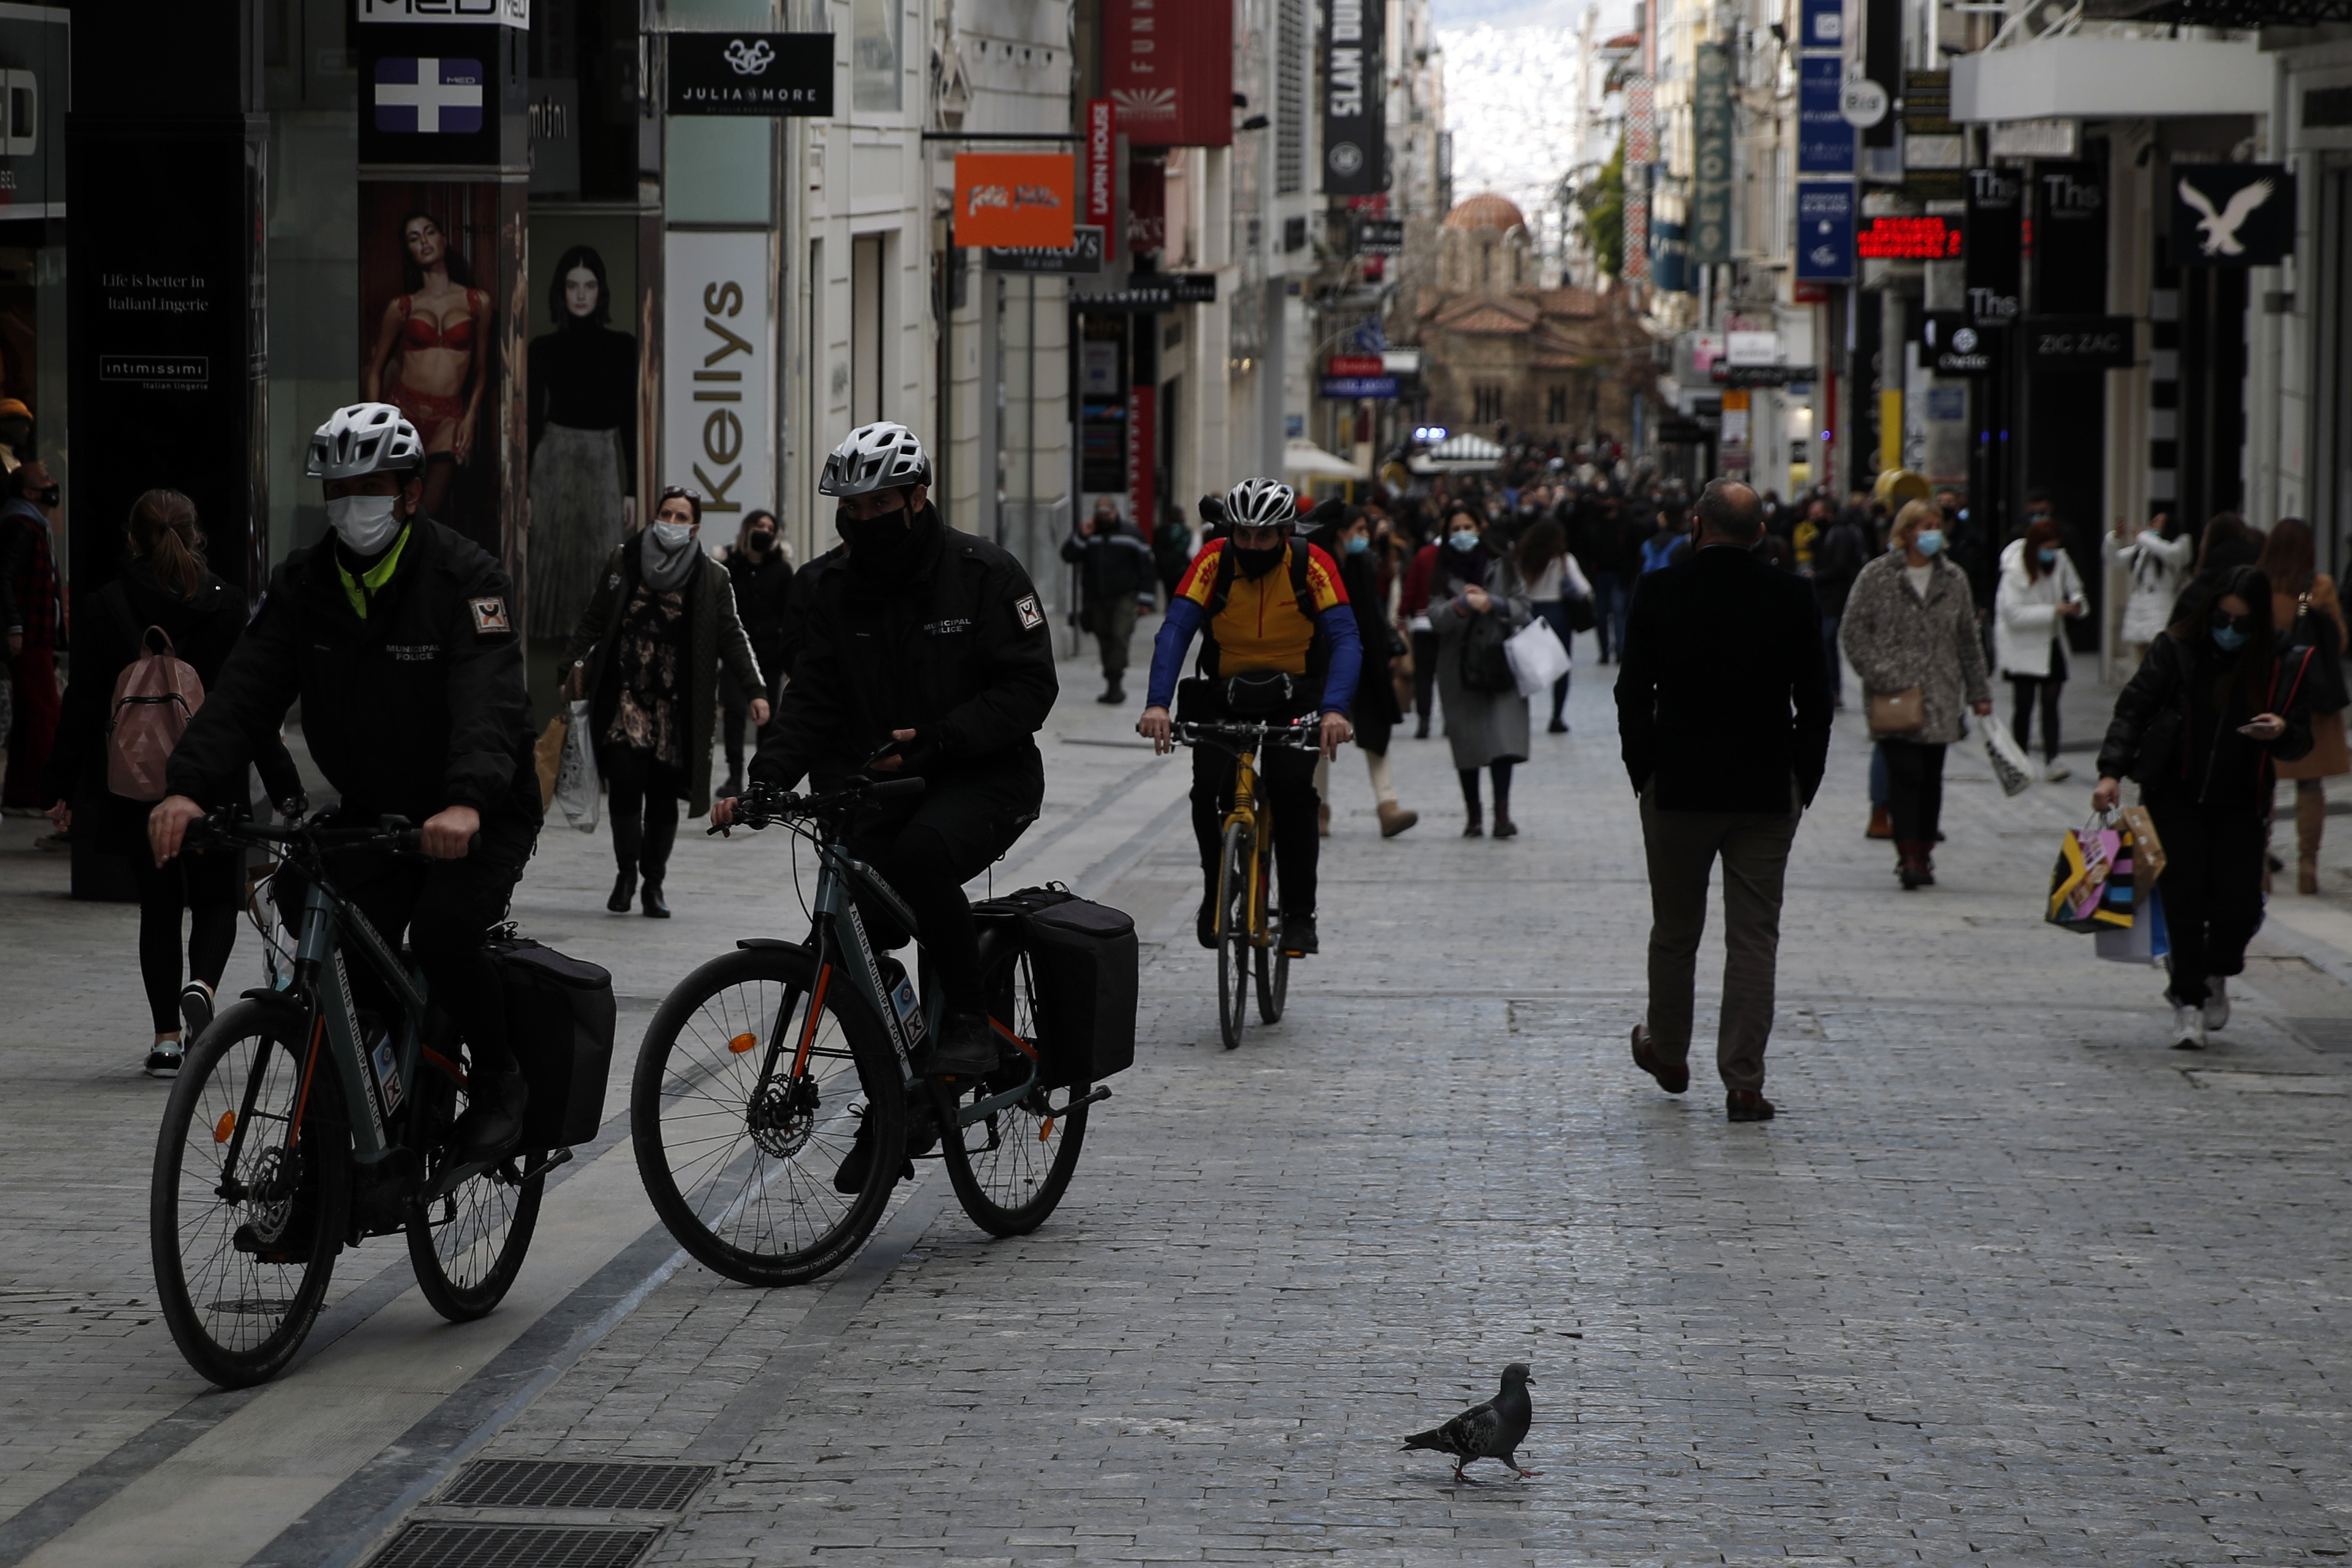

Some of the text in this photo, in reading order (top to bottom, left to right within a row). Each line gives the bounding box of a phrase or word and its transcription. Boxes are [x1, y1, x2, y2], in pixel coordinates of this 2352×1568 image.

[1330, 47, 1363, 117] SLAM
[683, 87, 817, 102] JULIA MORE
[1092, 102, 1110, 215] LAPIN HOUSE
[103, 273, 205, 288] Life is better in
[106, 362, 201, 374] intimissimi
[174, 382, 209, 391] lingerie
[386, 644, 441, 653] MUNICIPAL
[396, 652, 434, 660] POLICE
[851, 910, 908, 1065] ATHENS MUNICIPAL POLICE
[336, 957, 382, 1134] ATHENS MUNICIPAL POLICE
[810, 1250, 838, 1269] CONTACT
[296, 1308, 314, 1342] CONTACT
